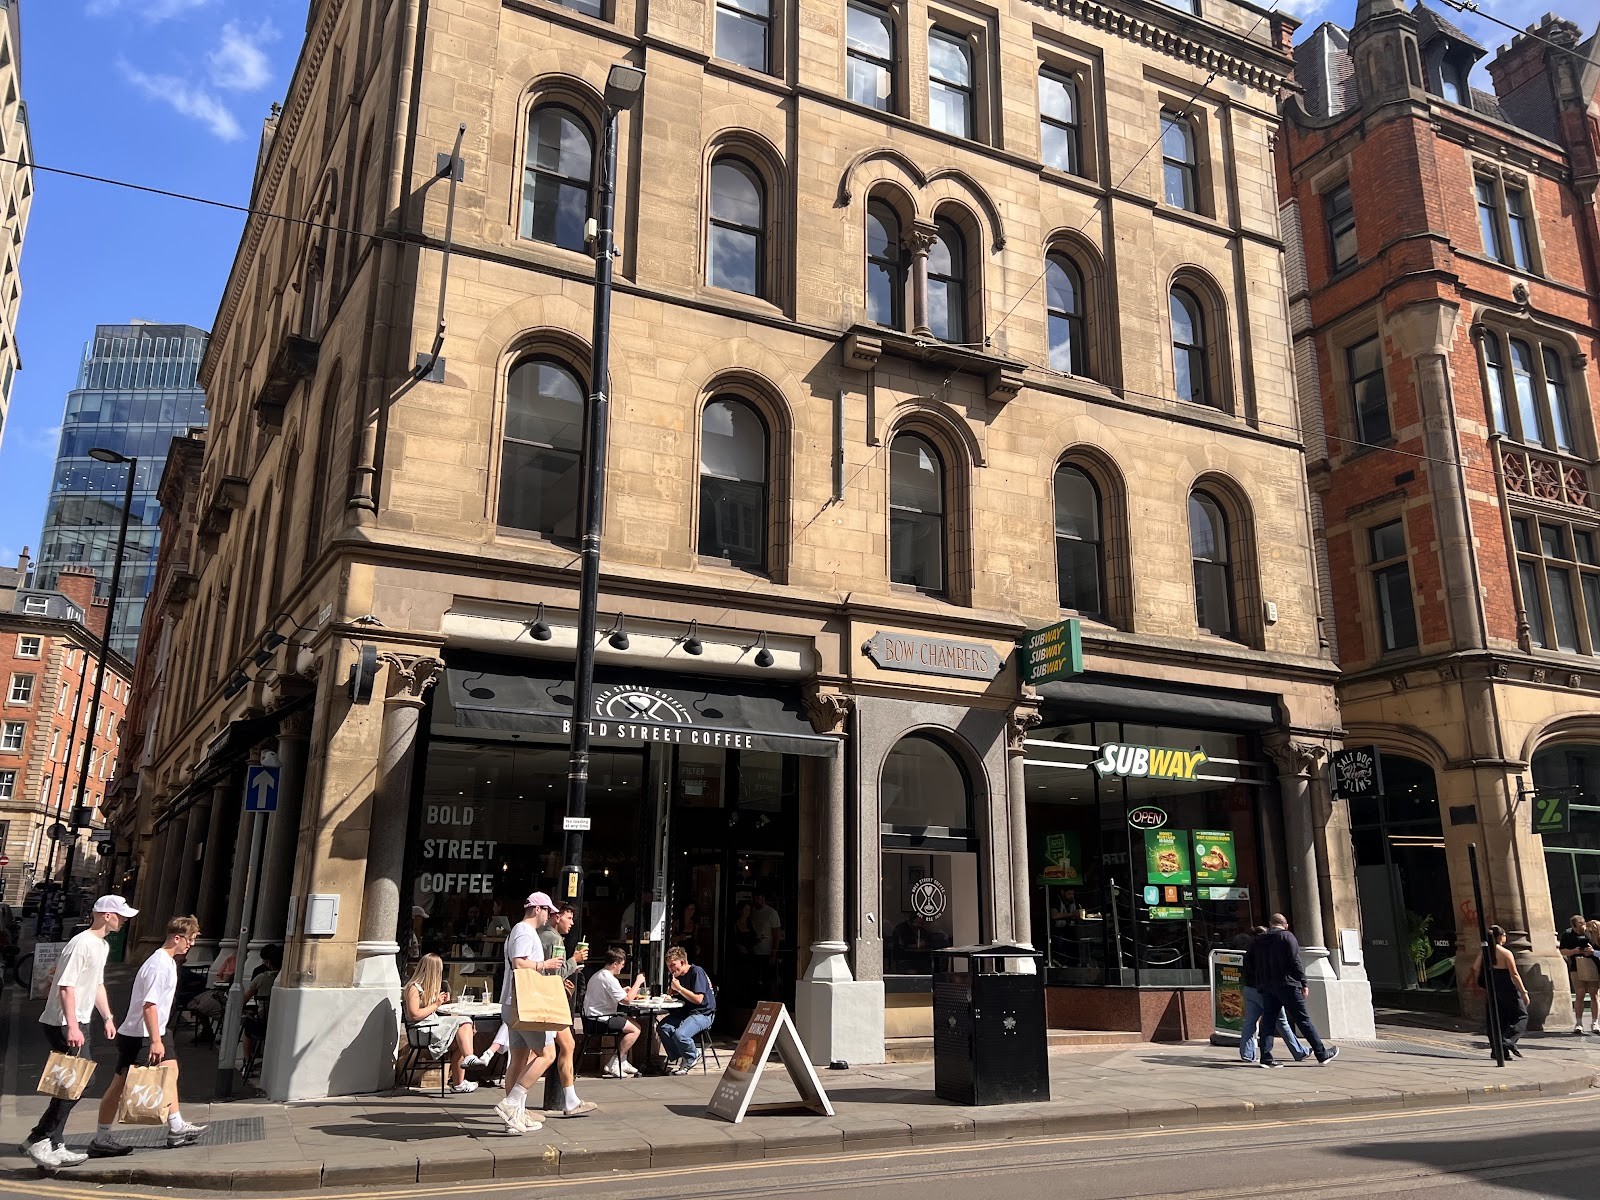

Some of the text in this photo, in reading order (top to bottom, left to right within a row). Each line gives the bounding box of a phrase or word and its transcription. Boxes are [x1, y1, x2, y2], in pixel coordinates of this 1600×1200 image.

[1028, 626, 1065, 649] SUBWAY
[884, 638, 989, 673] BOW CHAMBERS
[1029, 641, 1066, 664] SUBWAY
[1030, 657, 1067, 680] SUBWAY
[614, 684, 650, 694] STREET
[655, 690, 687, 714] COFFEE
[562, 719, 752, 749] BLD STREET COFFEE
[1097, 744, 1207, 780] SUBWAY
[1336, 751, 1373, 771] SALT DOG
[1343, 777, 1372, 793] SLIMS
[426, 805, 475, 826] BOLD
[1132, 810, 1162, 825] OPEN
[423, 838, 498, 860] STREET
[420, 872, 494, 894] COFFEE
[1433, 939, 1450, 947] TACOS
